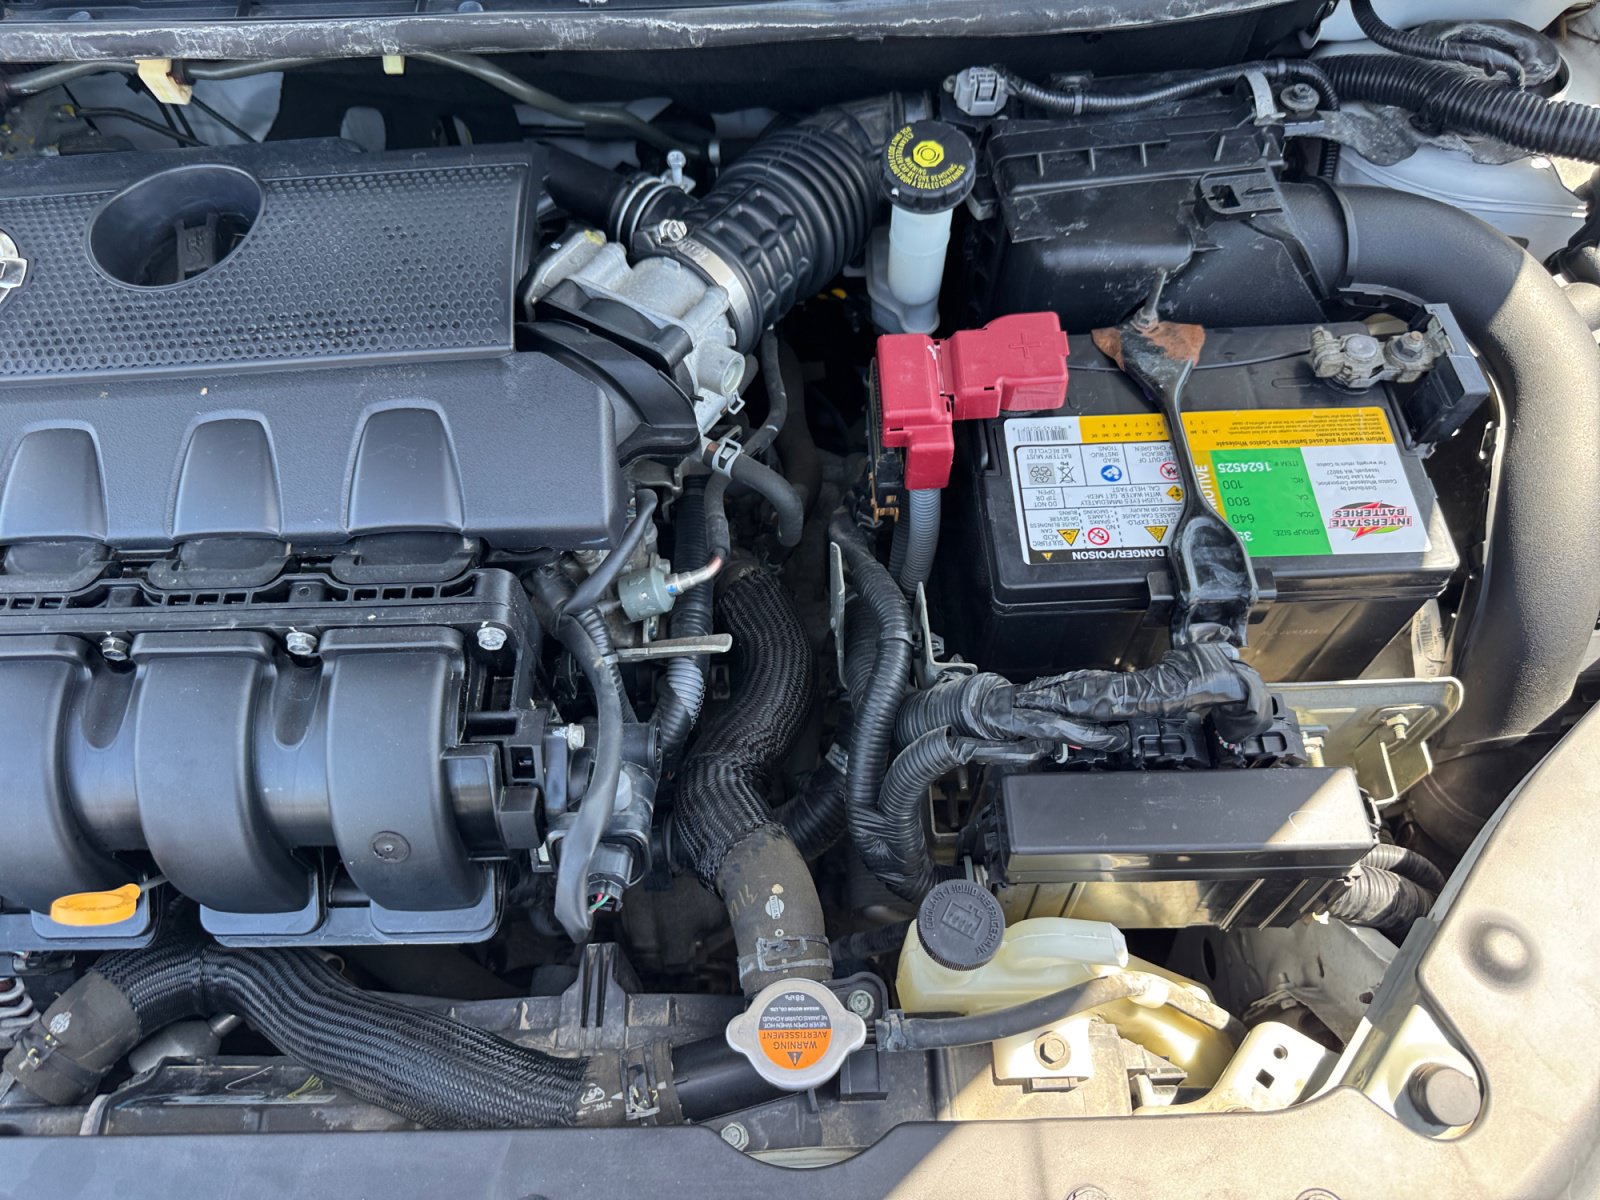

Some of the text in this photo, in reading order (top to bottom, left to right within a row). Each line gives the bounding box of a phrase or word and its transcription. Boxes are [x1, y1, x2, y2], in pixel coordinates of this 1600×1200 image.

[905, 157, 927, 176] WARNING
[899, 163, 910, 173] CAP
[907, 171, 929, 182] BEFORE
[930, 163, 958, 181] REMOVING
[911, 179, 917, 188] A
[917, 181, 939, 190] SEALED
[940, 164, 966, 187] CONTAINER
[1217, 462, 1272, 472] 1624525
[1222, 480, 1244, 490] 100
[1080, 498, 1121, 506] IMMEDIATELY
[1226, 496, 1250, 506] 800
[1334, 508, 1404, 517] BATTERIES
[1231, 513, 1255, 524] 640
[1332, 518, 1410, 528] INTERSTATE
[1272, 529, 1291, 537] SIZE:
[1072, 548, 1165, 560] DANGER/POISON
[762, 1031, 827, 1039] AVERTISSEMENT
[773, 1041, 817, 1049] WARNING
